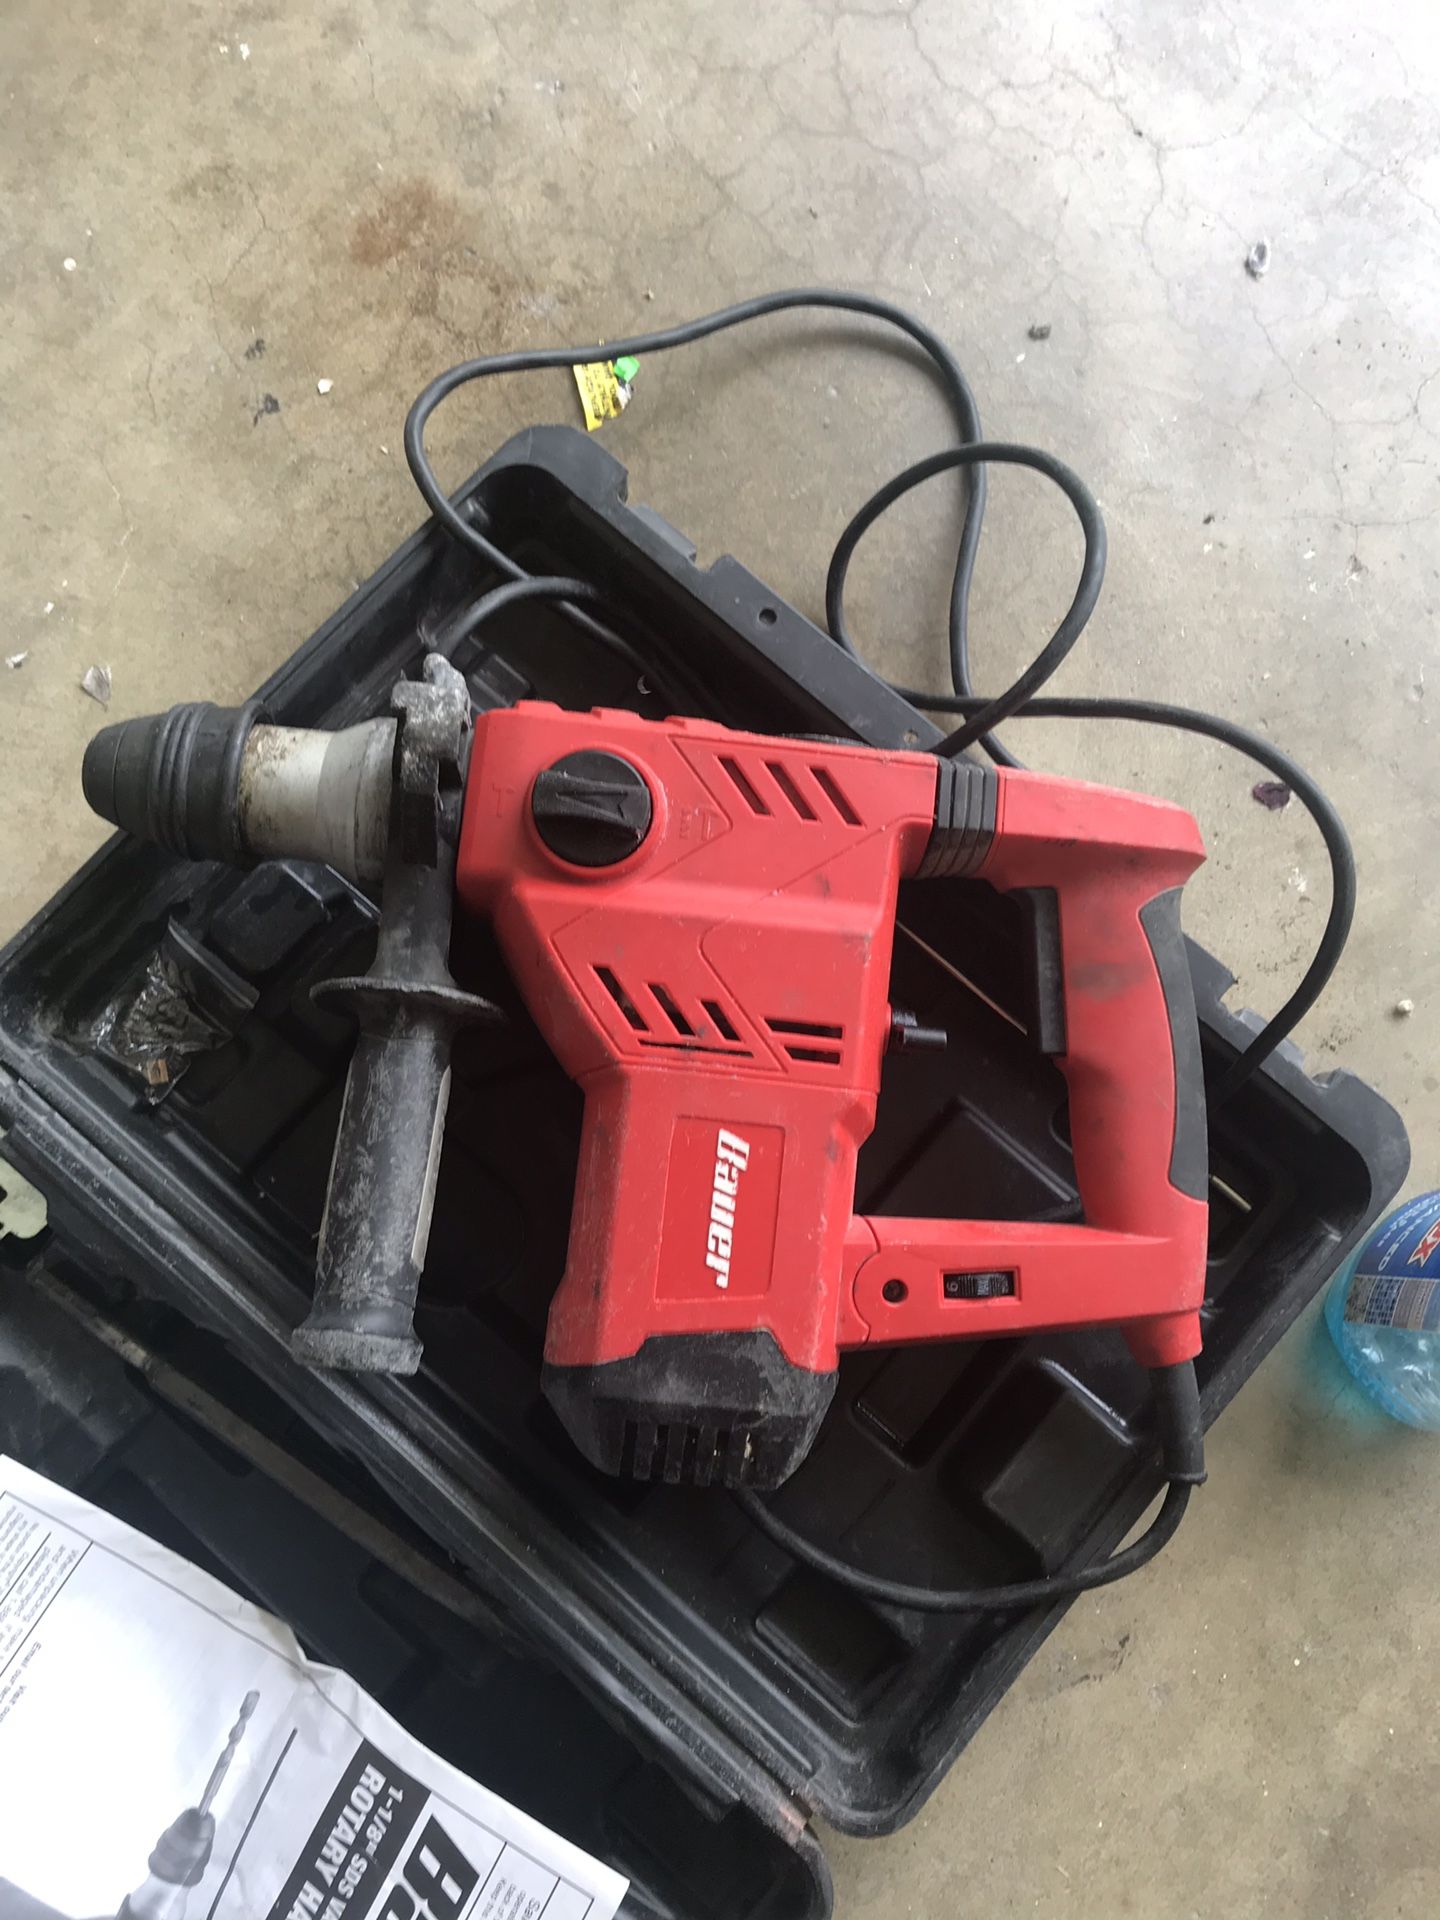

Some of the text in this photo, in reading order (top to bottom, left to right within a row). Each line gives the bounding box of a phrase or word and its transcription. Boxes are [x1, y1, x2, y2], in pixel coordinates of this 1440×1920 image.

[706, 1128, 750, 1289] Bauer
[314, 1763, 387, 1888] ROTARY
[337, 1852, 368, 1899] SDS
